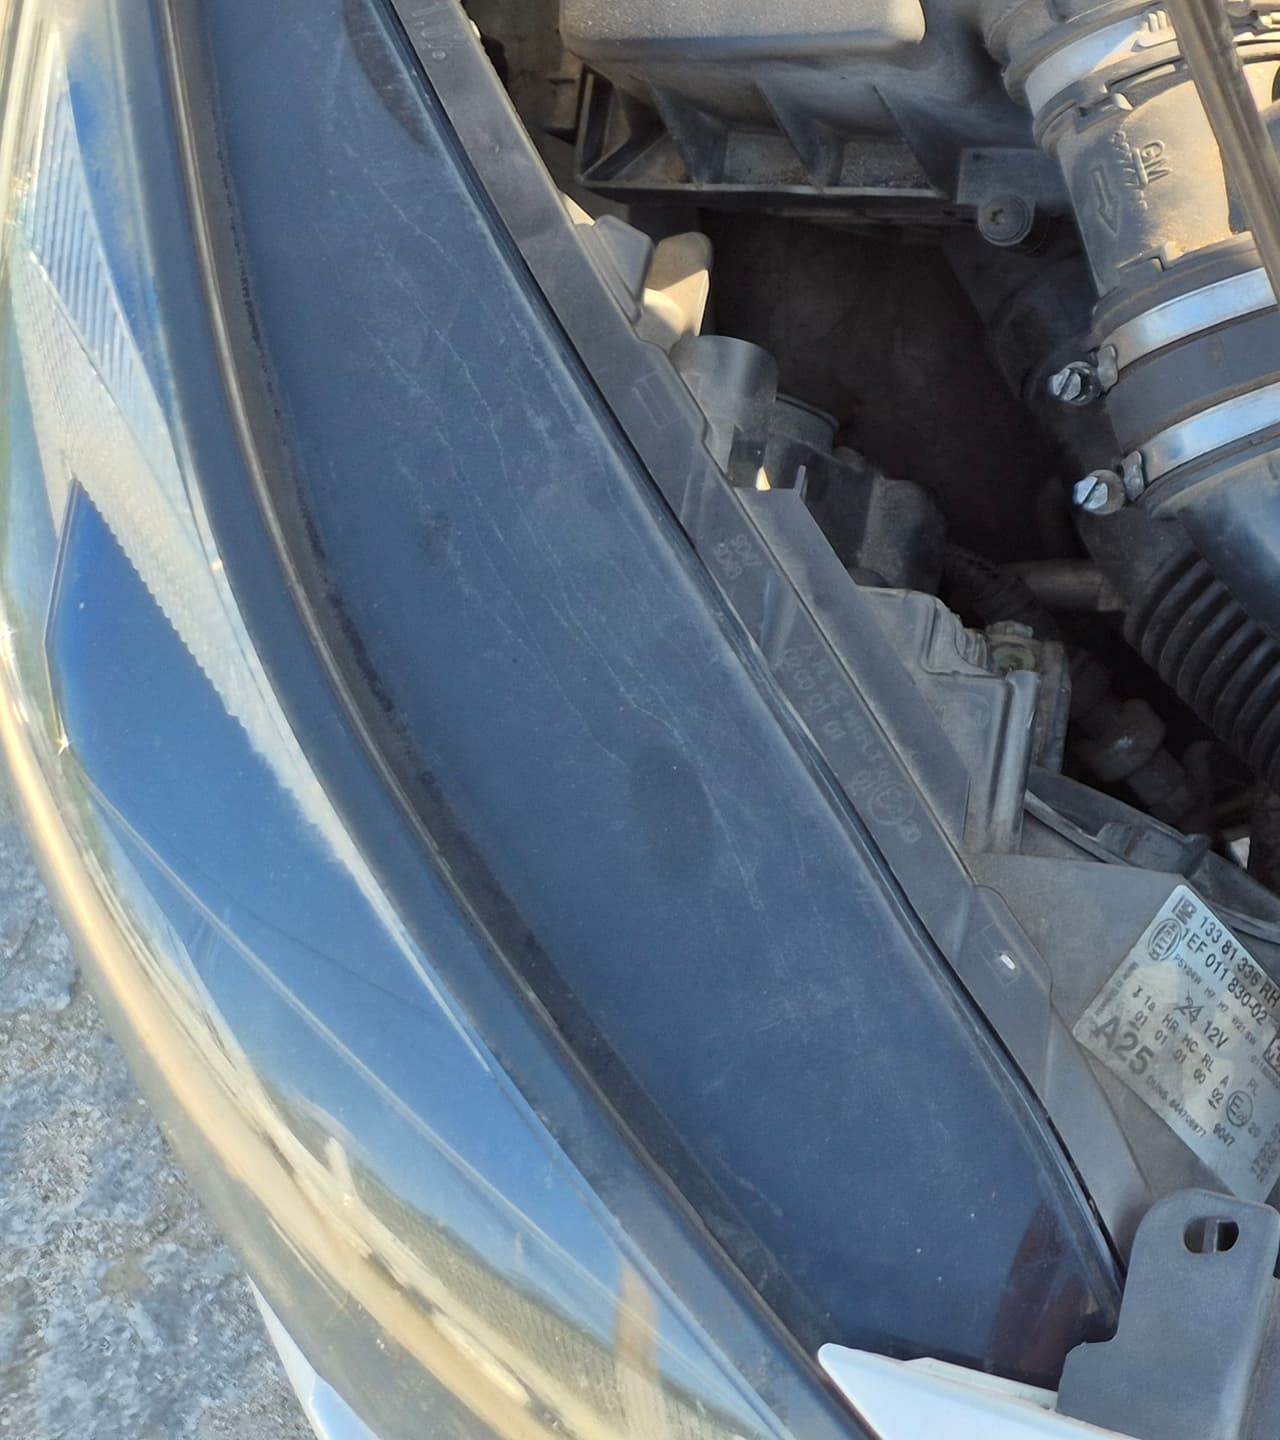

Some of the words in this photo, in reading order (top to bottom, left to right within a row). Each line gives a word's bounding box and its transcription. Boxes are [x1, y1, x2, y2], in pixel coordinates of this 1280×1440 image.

[1149, 922, 1178, 961] HELLA
[1199, 916, 1220, 944] 133
[1221, 939, 1238, 961] 81
[1260, 982, 1280, 1006] RH
[1181, 928, 1208, 960] 1EF
[1205, 957, 1227, 982] 011
[1228, 978, 1269, 1026] 830-02
[1091, 1016, 1154, 1075] A25
[1203, 1020, 1229, 1049] 12V
[1202, 1053, 1214, 1073] RL
[1220, 1075, 1230, 1089] A
[1213, 1123, 1235, 1147] 9047
